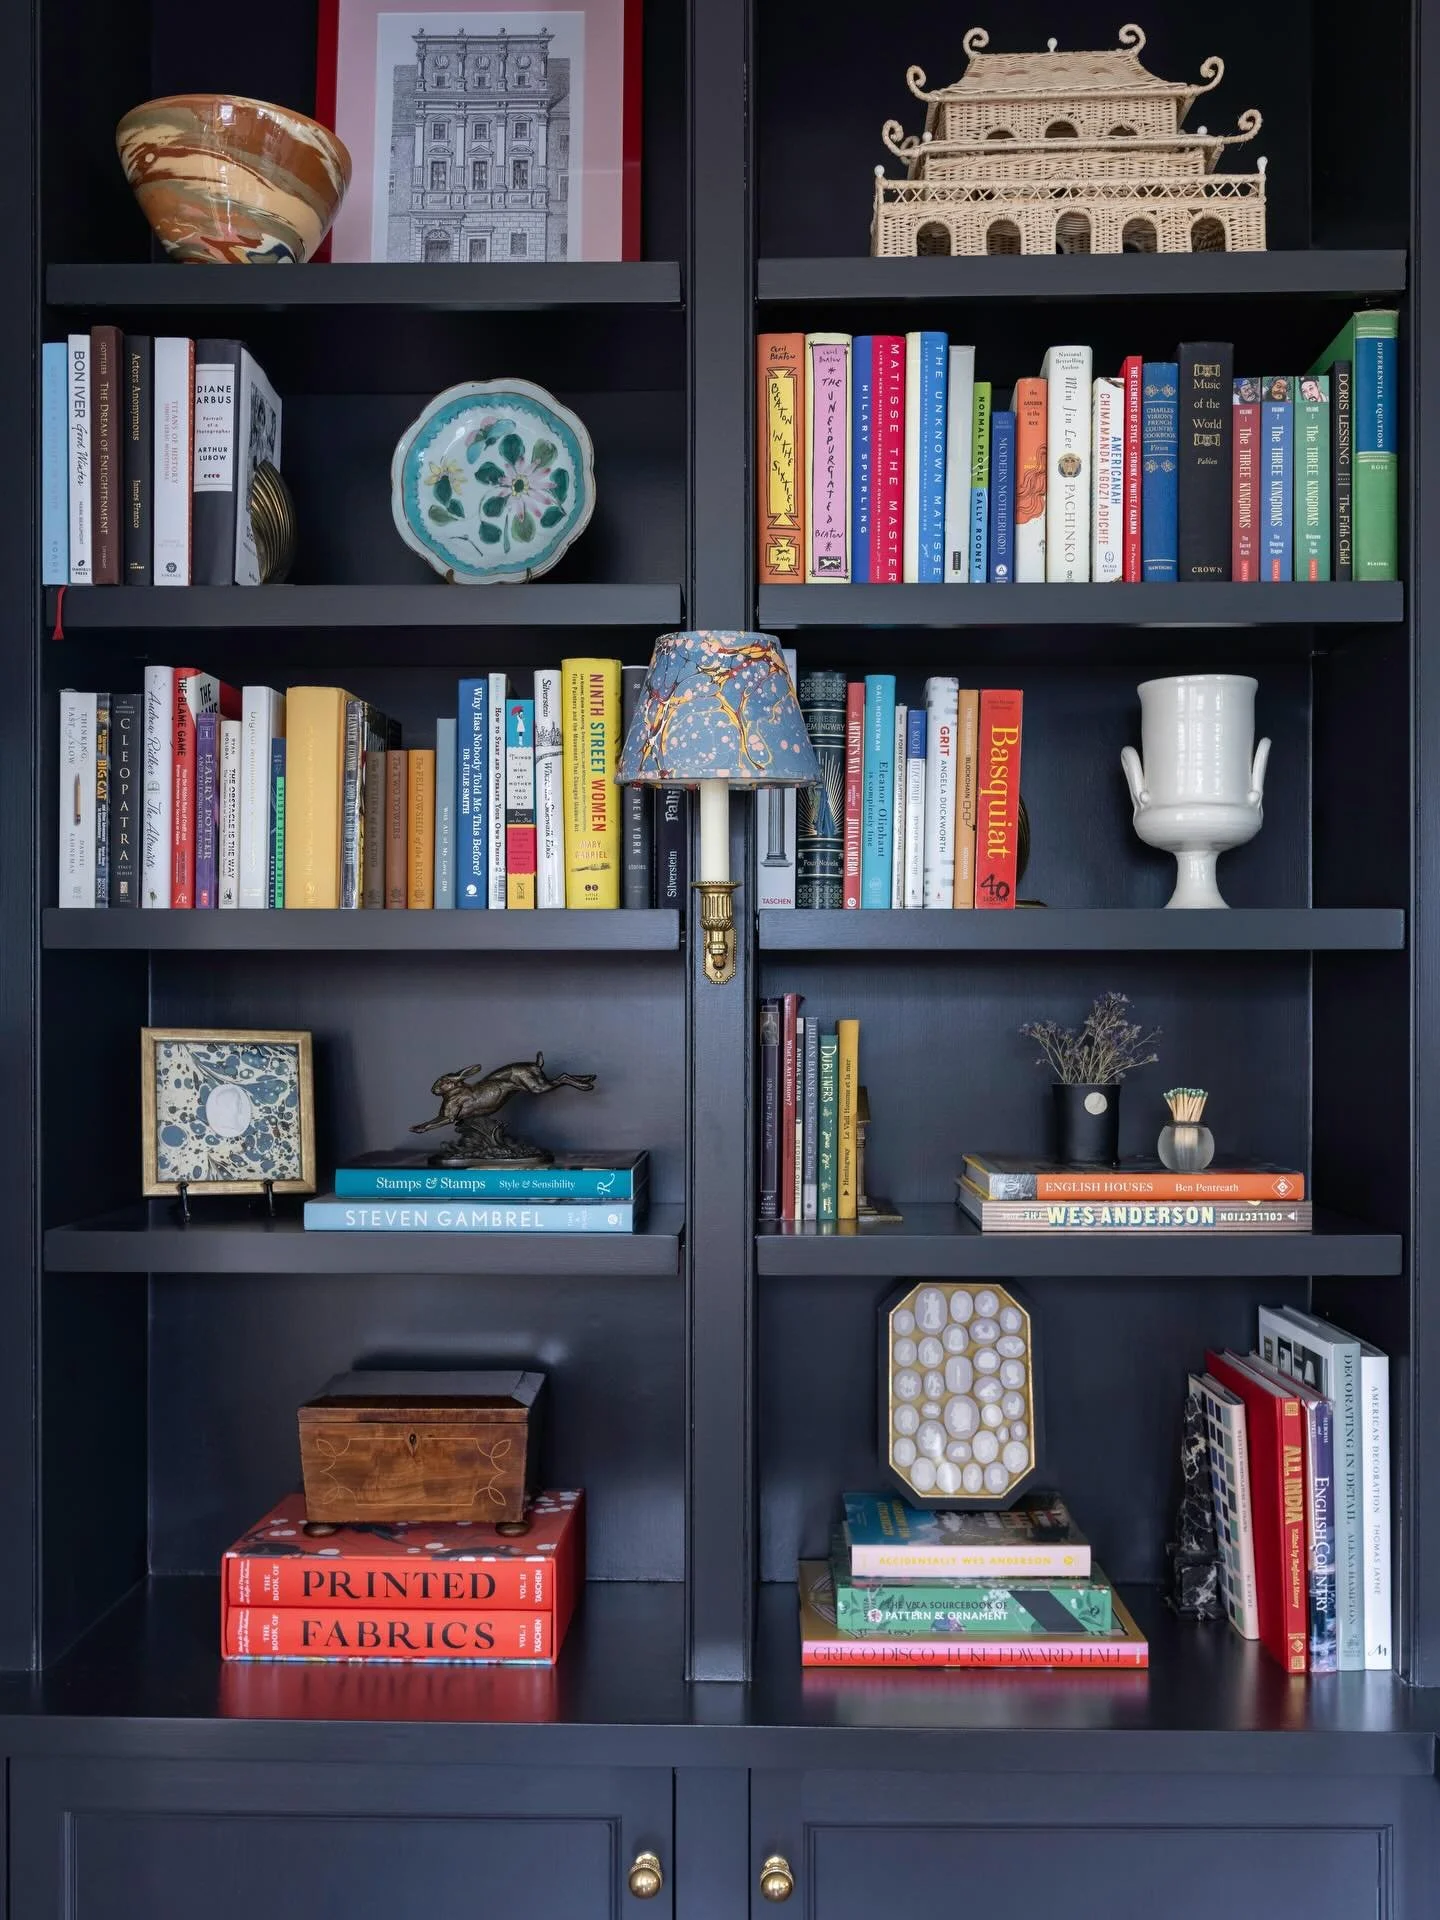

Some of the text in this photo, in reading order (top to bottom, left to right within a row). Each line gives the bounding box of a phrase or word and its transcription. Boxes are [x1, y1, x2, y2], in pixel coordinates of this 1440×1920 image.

[74, 351, 86, 418] BON IVER
[1130, 366, 1138, 378] THE
[1192, 379, 1220, 390] Music
[130, 353, 141, 441] Actors Anonymous
[196, 396, 232, 404] ARBUS
[976, 396, 984, 439] NORMAL
[1130, 380, 1138, 412] ELEMENTS
[1130, 414, 1138, 422] OF
[1194, 399, 1220, 408] of the
[1130, 424, 1138, 443] STYLE
[1192, 418, 1222, 429] World
[1240, 428, 1252, 444] The
[72, 424, 88, 487] Good Winter
[100, 382, 108, 534] THE DREAM OF ENLIGHTENMENT
[888, 344, 899, 582] MATISSE THE MASTER
[976, 444, 984, 482] PEOPLE
[998, 438, 1008, 483] MODERN
[1062, 376, 1078, 563] Min Jin Lee PACHINKO
[1099, 393, 1110, 544] CHIMAMANDA NGOZI ADICHIE
[1111, 436, 1122, 504] AMERICANAH
[1239, 450, 1252, 478] THREE
[1338, 374, 1350, 564] DORIS LESSING The Fifth Child
[132, 480, 141, 528] James Franco
[998, 485, 1008, 555] MOTHERHOOD
[1238, 483, 1252, 528] KINGDOMS
[176, 677, 187, 756] THE BLAME GAME
[463, 748, 469, 760] DR
[590, 674, 606, 832] NINTH STREET WOMEN
[940, 726, 950, 756] GRIT
[97, 760, 106, 800] BIG CAT
[120, 718, 130, 862] CLEOPATRA
[146, 692, 162, 868] Andrew Ridker The Altruists
[471, 688, 482, 876] Why Has Nobody Told Me This Before?
[847, 720, 859, 877] ARTIST'S WAY JULIA CAMERON
[980, 724, 1019, 860] Basquiat
[204, 754, 212, 859] HARRY POTTER
[632, 798, 641, 820] NEW
[876, 762, 888, 857] Eleanor Oliphant
[939, 798, 947, 852] DUCKWORTH
[632, 828, 641, 855] YORK
[666, 851, 678, 897] Silverstein
[821, 1045, 836, 1102] DUBLINERS
[376, 1177, 576, 1191] Stamps & Stamps Style & Sensibility
[1046, 1182, 1239, 1193] ENGLISH HOUSES Ben Pentreath
[346, 1210, 544, 1227] STEVEN GAMBREL
[1048, 1206, 1216, 1226] WES ANDERSON
[1220, 1213, 1282, 1222] COLLECTION
[1371, 1386, 1379, 1441] AMERICAN
[1284, 1446, 1303, 1525] ALL INDIA
[1344, 1354, 1357, 1624] DECORATING IN DETAIL ALEXA HAMPTON
[1372, 1446, 1380, 1513] DECORATION
[1314, 1476, 1330, 1612] ENGLISH COUNTRY
[302, 1570, 496, 1599] PRINTED
[534, 1569, 542, 1603] TASCHEN
[300, 1620, 495, 1650] FABRICS
[885, 1611, 1008, 1620] PATTERN & ORNAMENT
[814, 1648, 1120, 1662] GRECO DISCO LUKE EDWARD HALL
